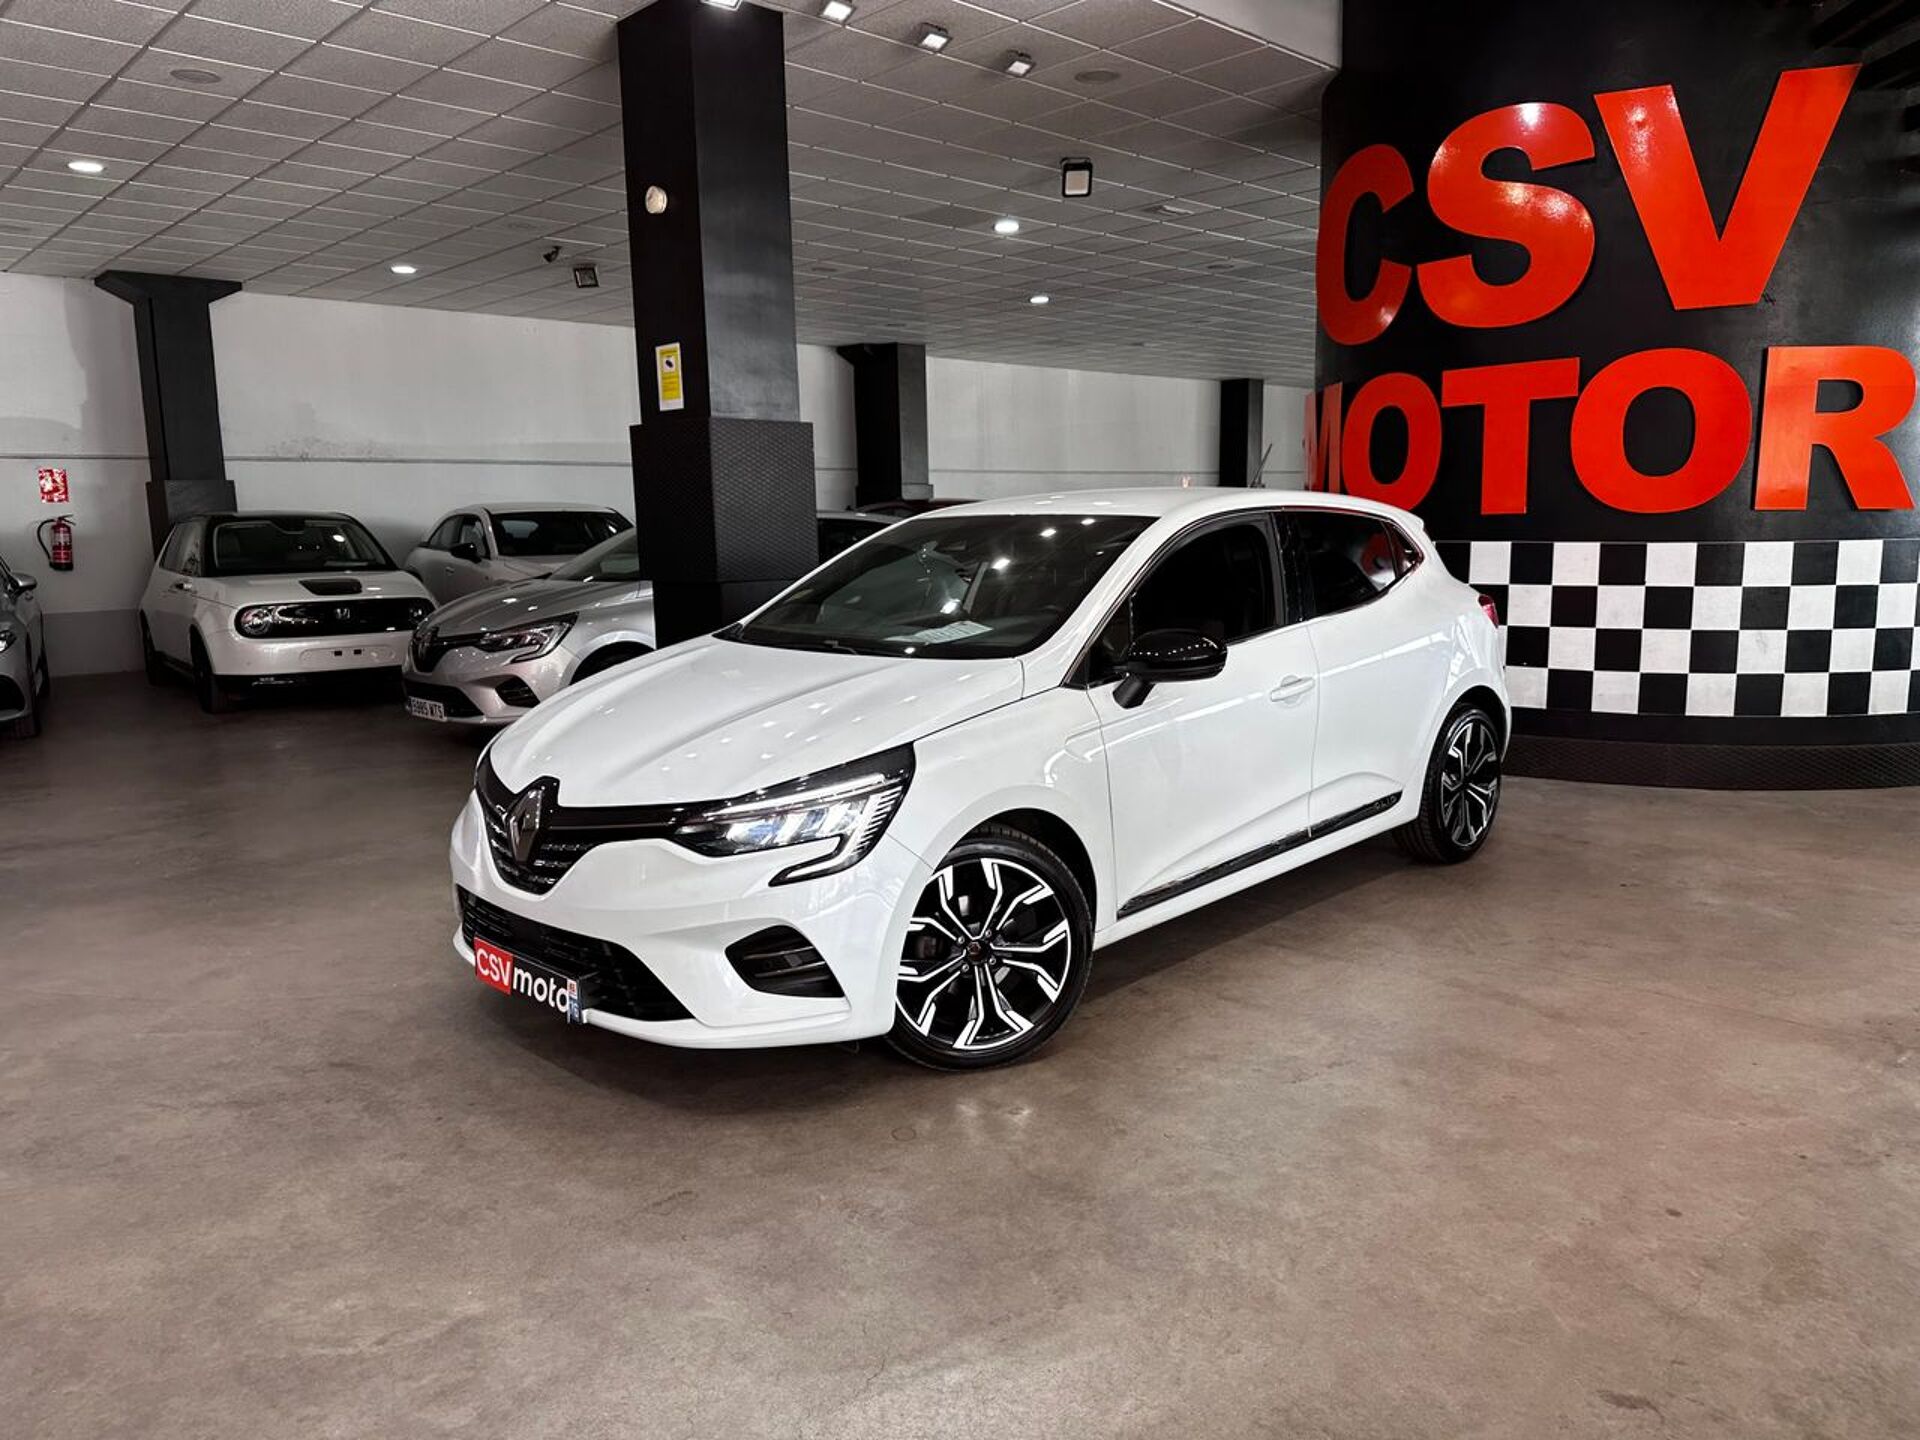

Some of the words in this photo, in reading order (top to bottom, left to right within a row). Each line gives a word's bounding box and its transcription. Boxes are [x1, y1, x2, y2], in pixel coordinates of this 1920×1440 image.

[1315, 63, 1862, 345] CSV
[1304, 345, 1917, 515] MOTOR
[476, 948, 570, 1013] CSVmoto
